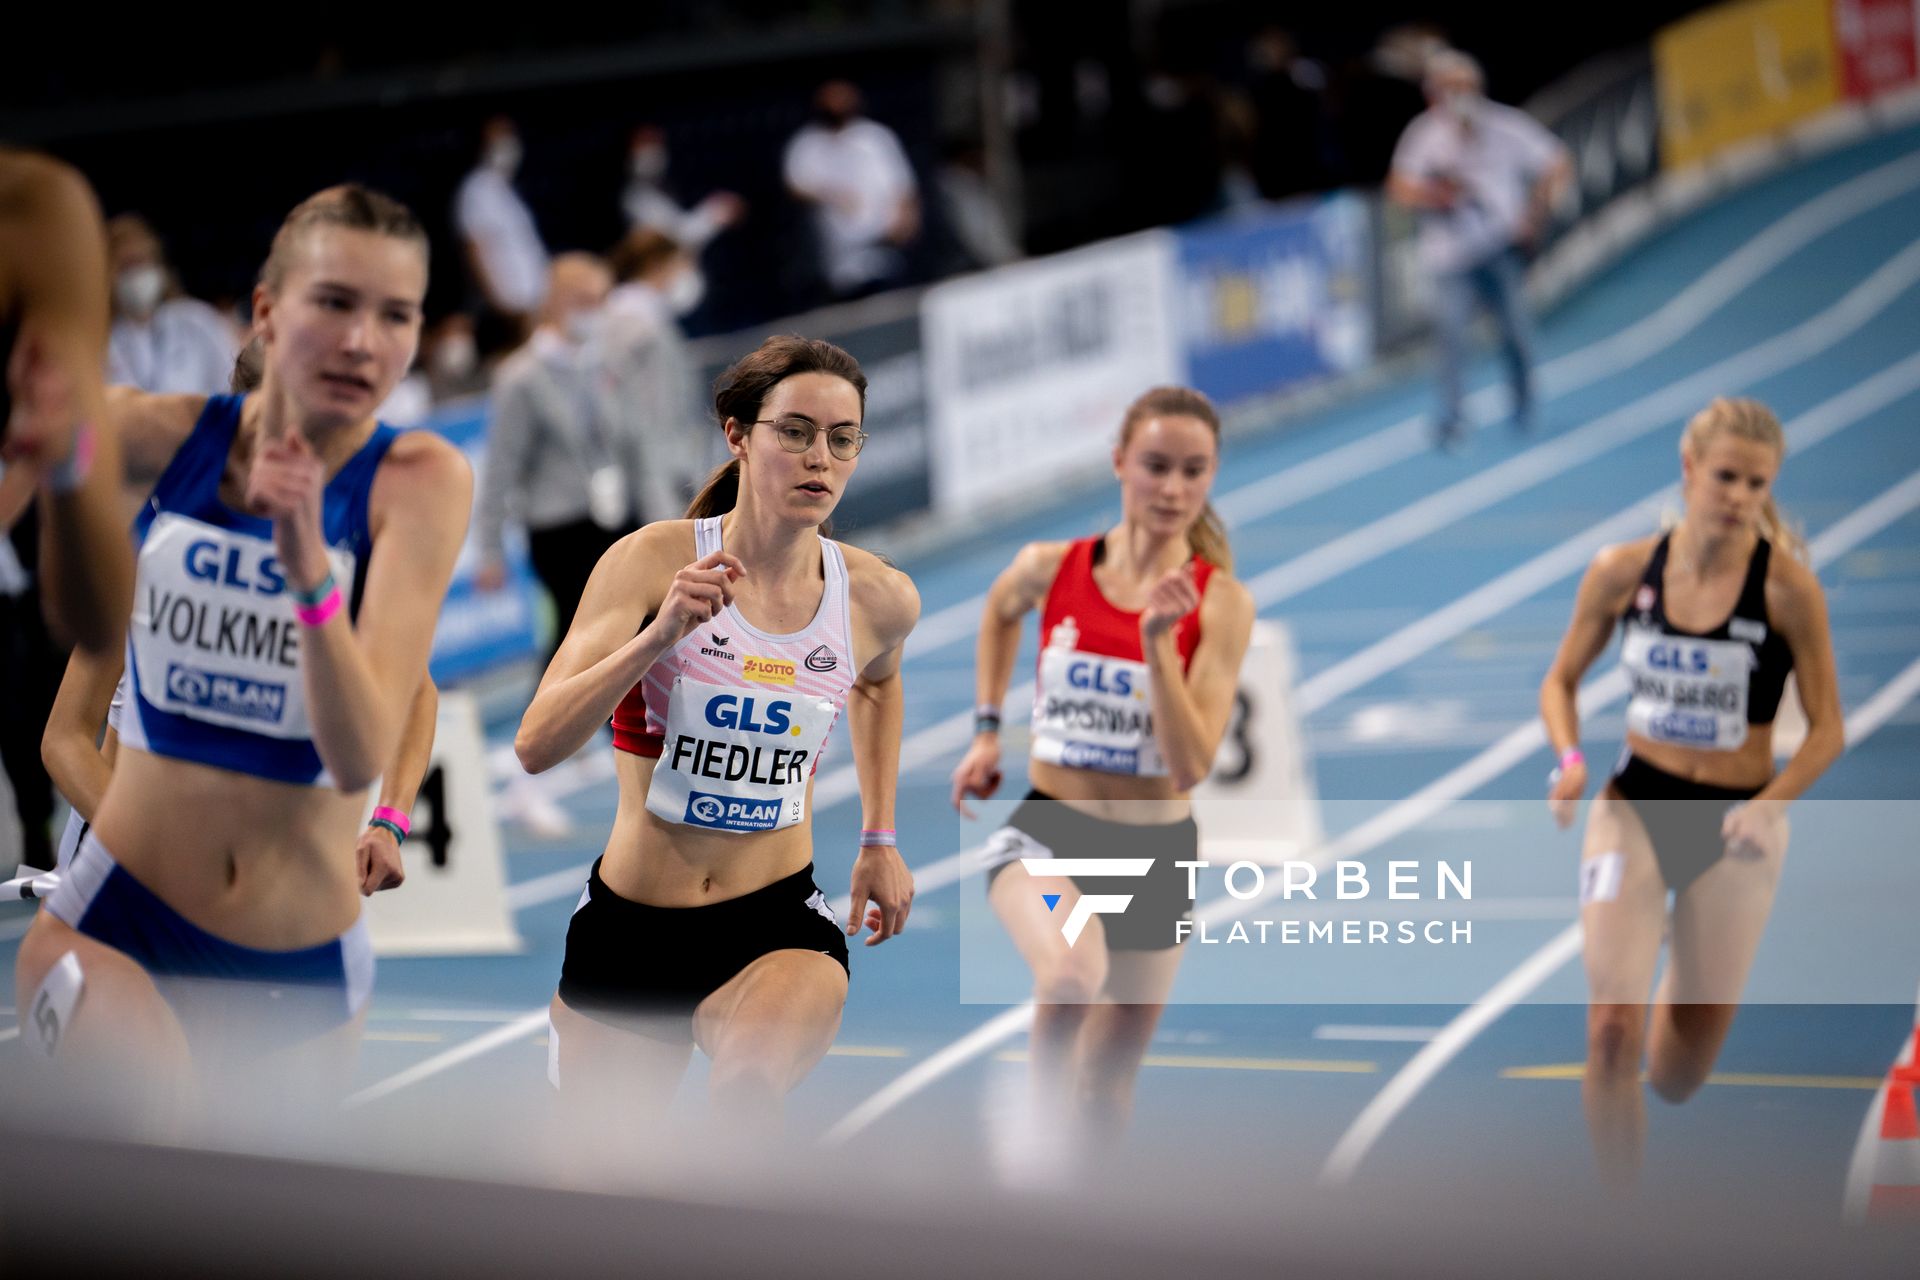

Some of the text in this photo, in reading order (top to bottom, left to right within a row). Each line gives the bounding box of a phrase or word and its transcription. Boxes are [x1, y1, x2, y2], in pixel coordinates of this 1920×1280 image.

[701, 646, 735, 662] erima
[759, 662, 795, 676] LOTTO
[211, 677, 281, 709] PLAN
[671, 734, 808, 786] FIEDLER
[727, 803, 778, 820] PLAN
[725, 819, 774, 828] INTERNATIONAL
